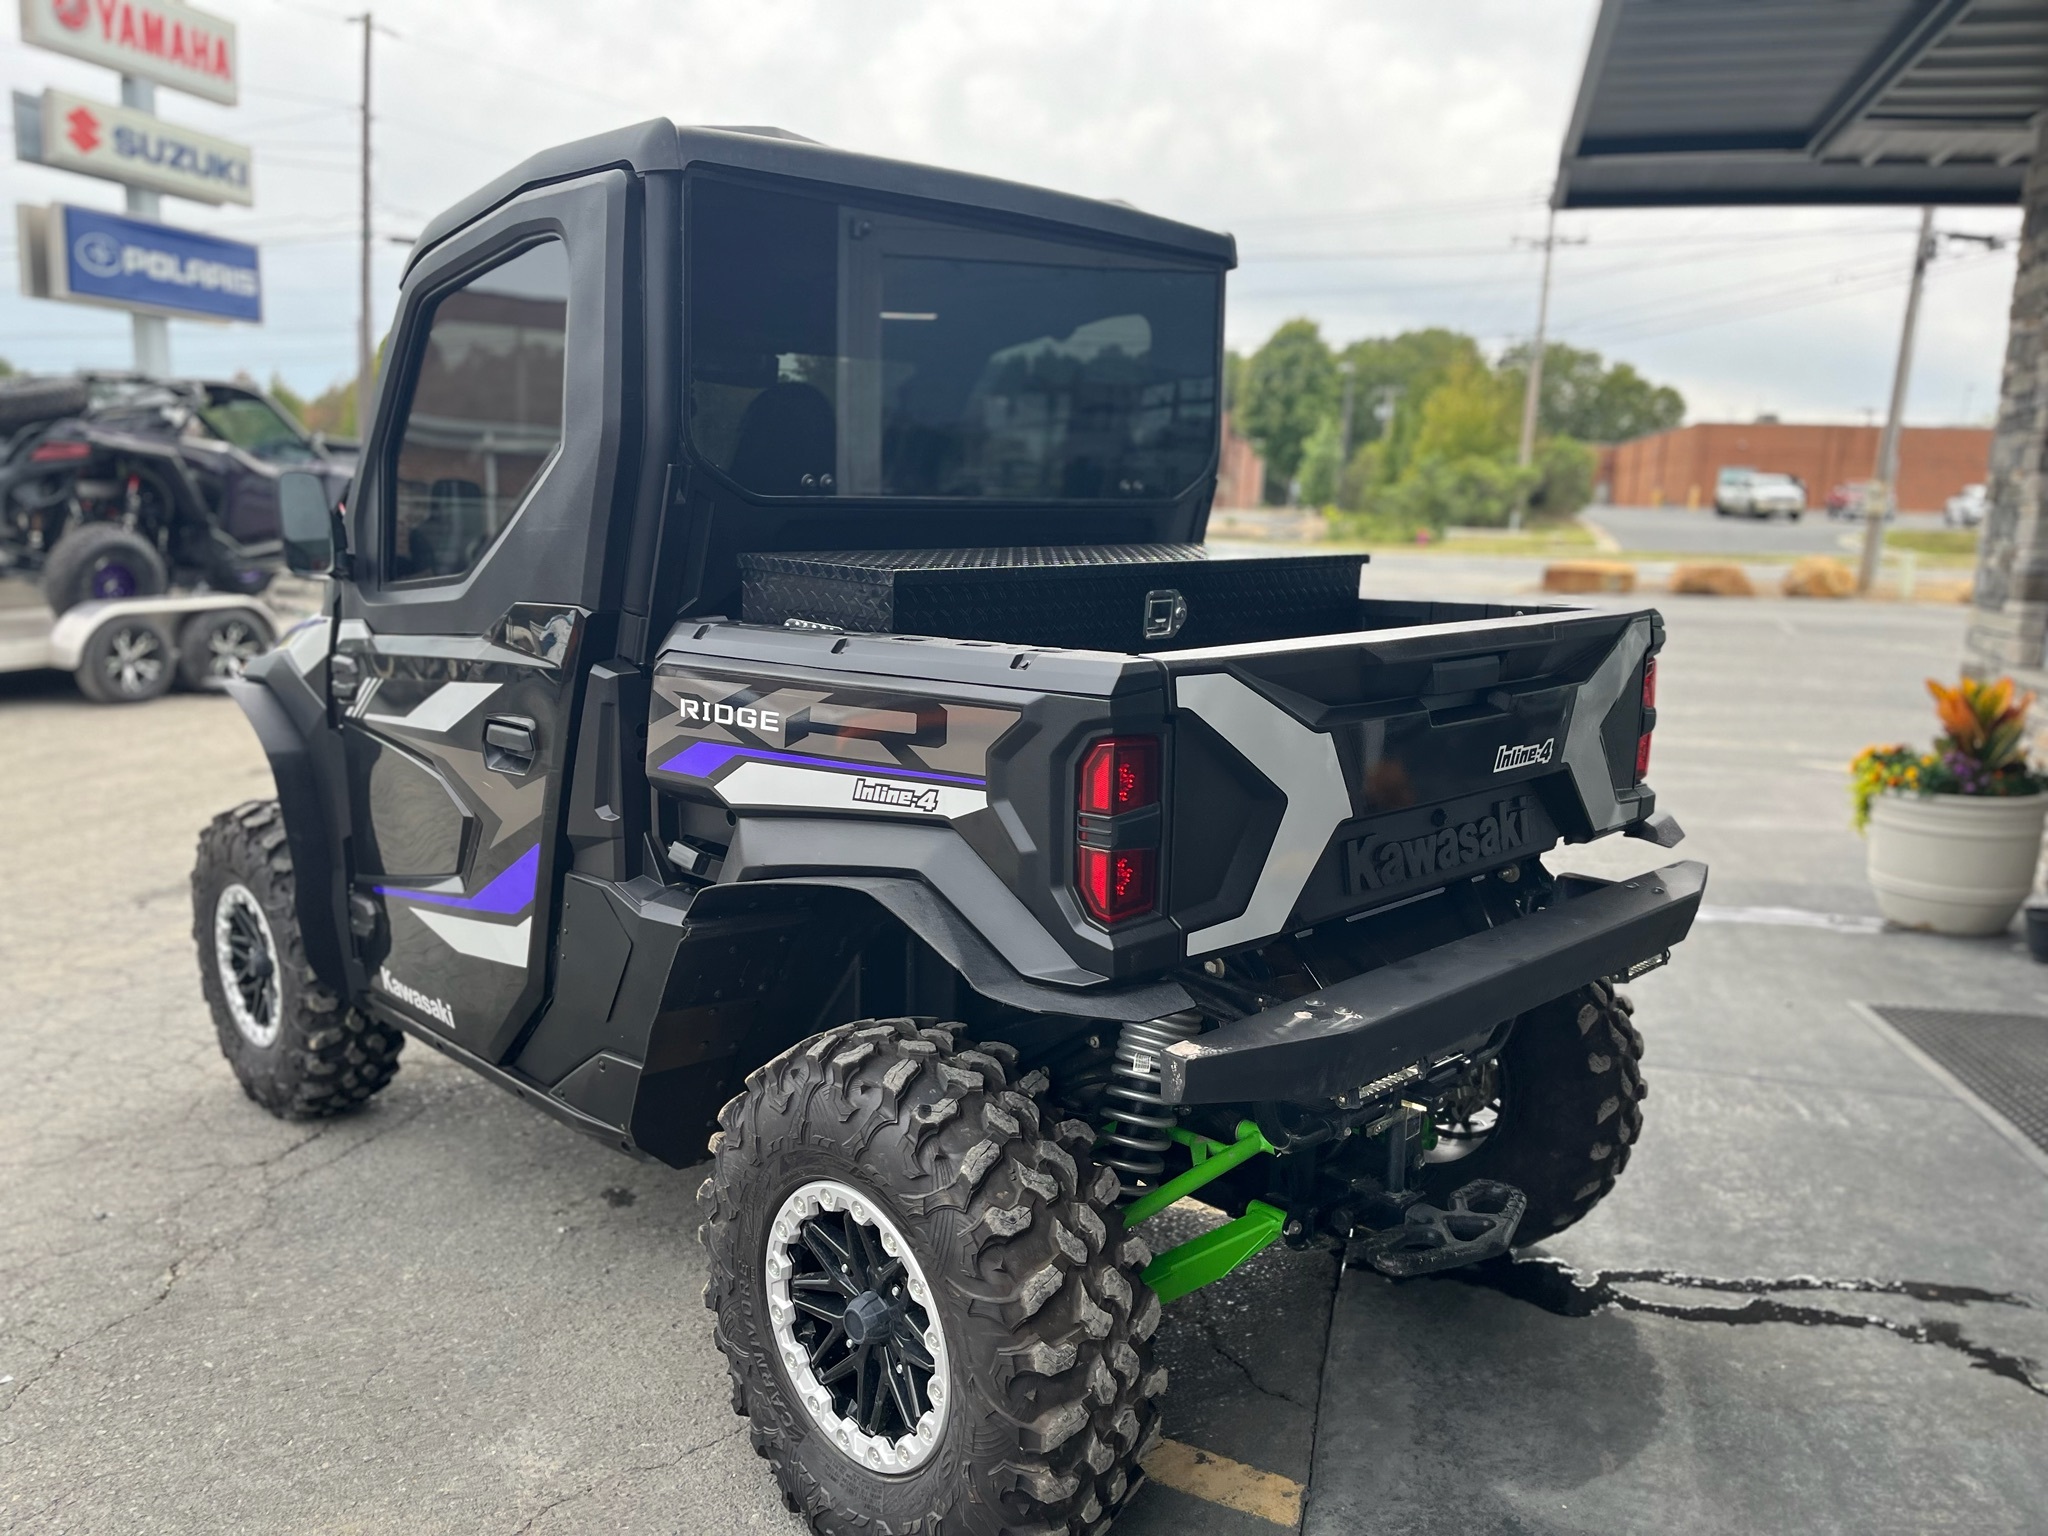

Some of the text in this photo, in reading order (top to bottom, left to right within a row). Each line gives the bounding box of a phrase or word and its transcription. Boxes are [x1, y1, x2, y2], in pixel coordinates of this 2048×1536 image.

[101, 0, 232, 81] YAMAHA
[113, 126, 249, 187] SUZUKI
[121, 247, 259, 297] POLARIS
[679, 698, 780, 733] RIDGE
[1493, 738, 1554, 773] Inline-4
[852, 778, 939, 812] Inline-4
[1346, 797, 1534, 894] Kawasaki
[380, 965, 456, 1029] Kawasaki
[737, 1258, 794, 1428] CARNIVORE
